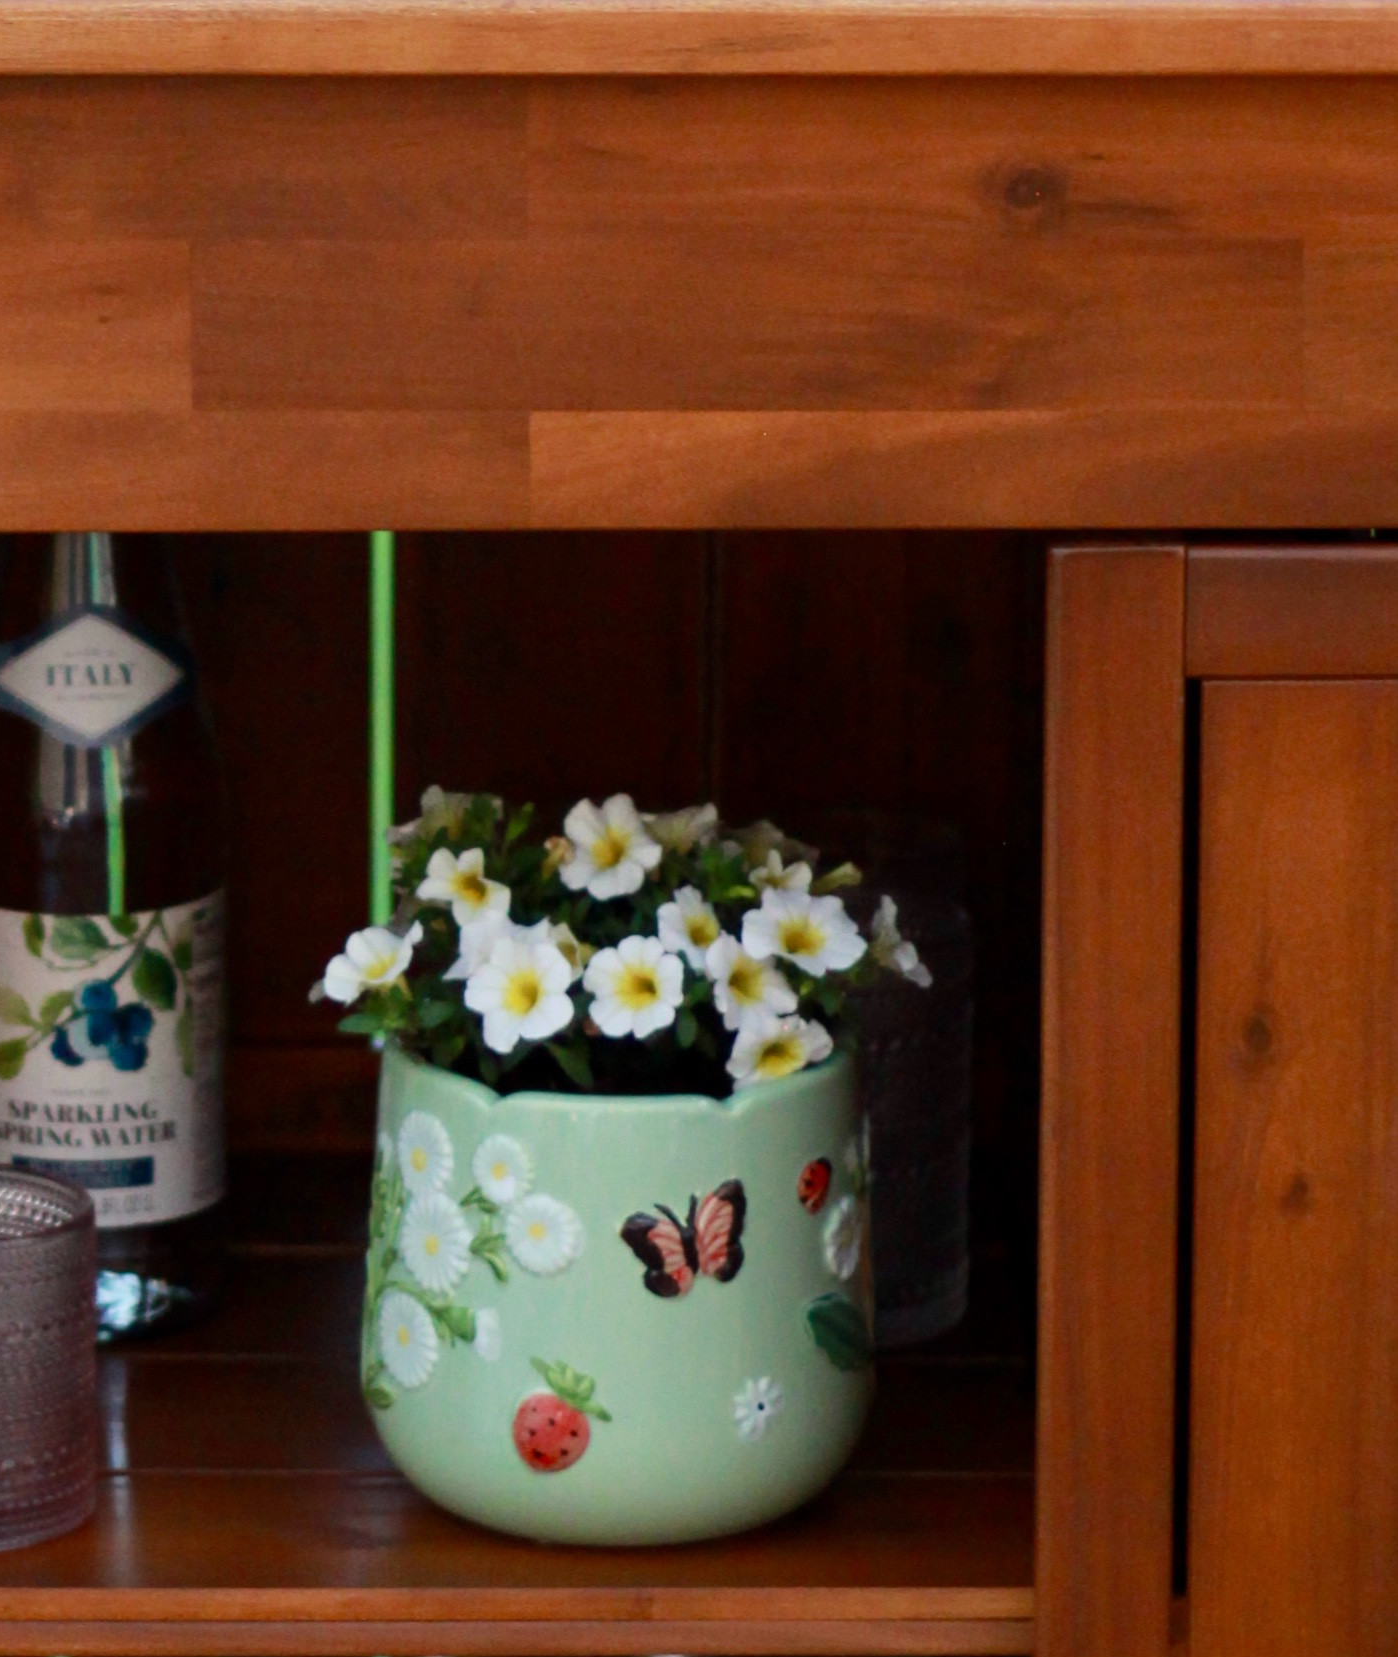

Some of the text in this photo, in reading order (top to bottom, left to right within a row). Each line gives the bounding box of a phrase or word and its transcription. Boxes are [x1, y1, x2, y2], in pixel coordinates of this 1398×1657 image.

[46, 663, 134, 686] ITALY
[7, 1102, 158, 1123] SPARKLING
[91, 1121, 177, 1146] WATER
